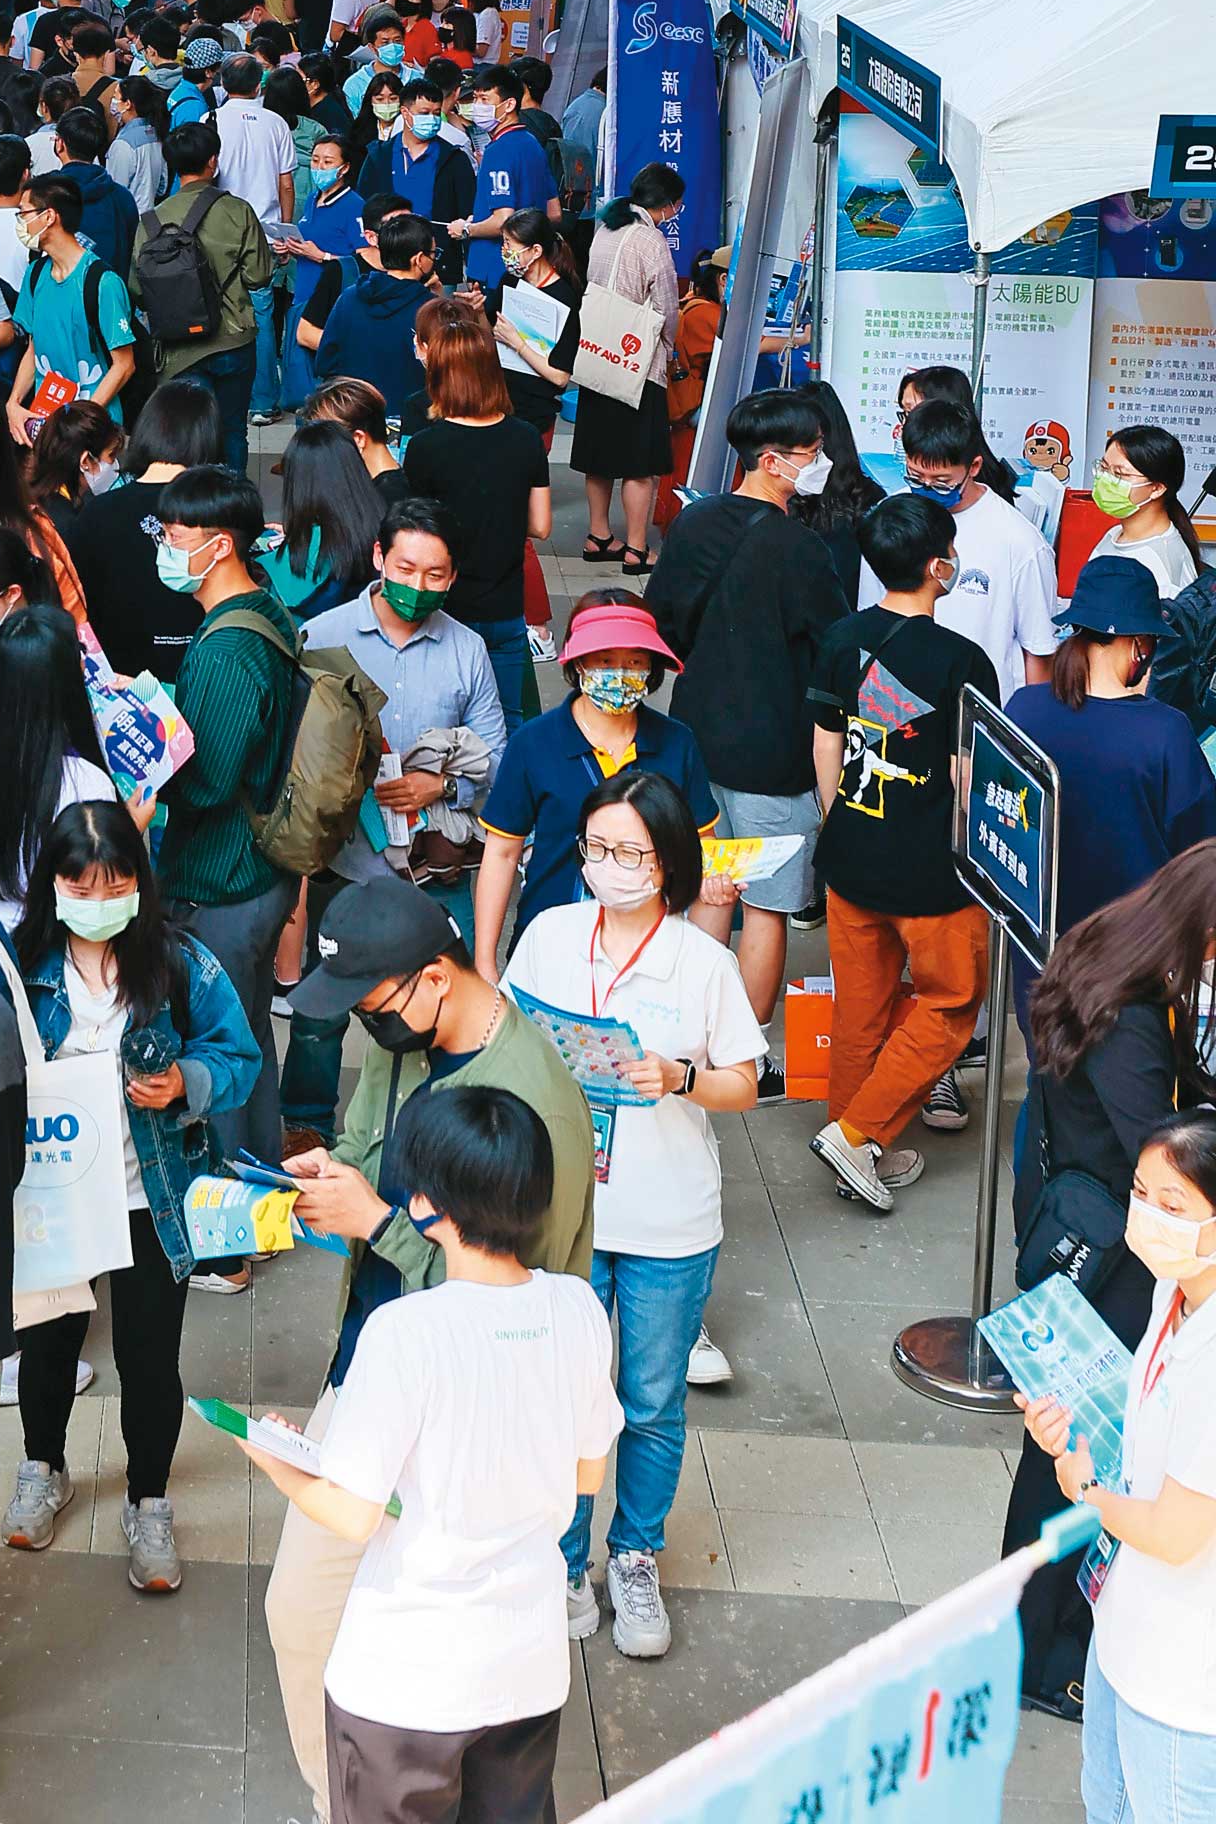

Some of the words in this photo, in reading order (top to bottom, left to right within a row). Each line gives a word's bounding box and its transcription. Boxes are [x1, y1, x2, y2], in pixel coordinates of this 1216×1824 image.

[841, 43, 851, 68] 25
[868, 56, 923, 122] 大同股份有限公司
[658, 70, 683, 154] 新應材
[1185, 144, 1216, 171] 2
[489, 170, 510, 191] 10
[992, 282, 1080, 304] 太陽能BU
[579, 339, 602, 354] WHY
[600, 350, 621, 364] AND
[622, 359, 640, 373] 1/2
